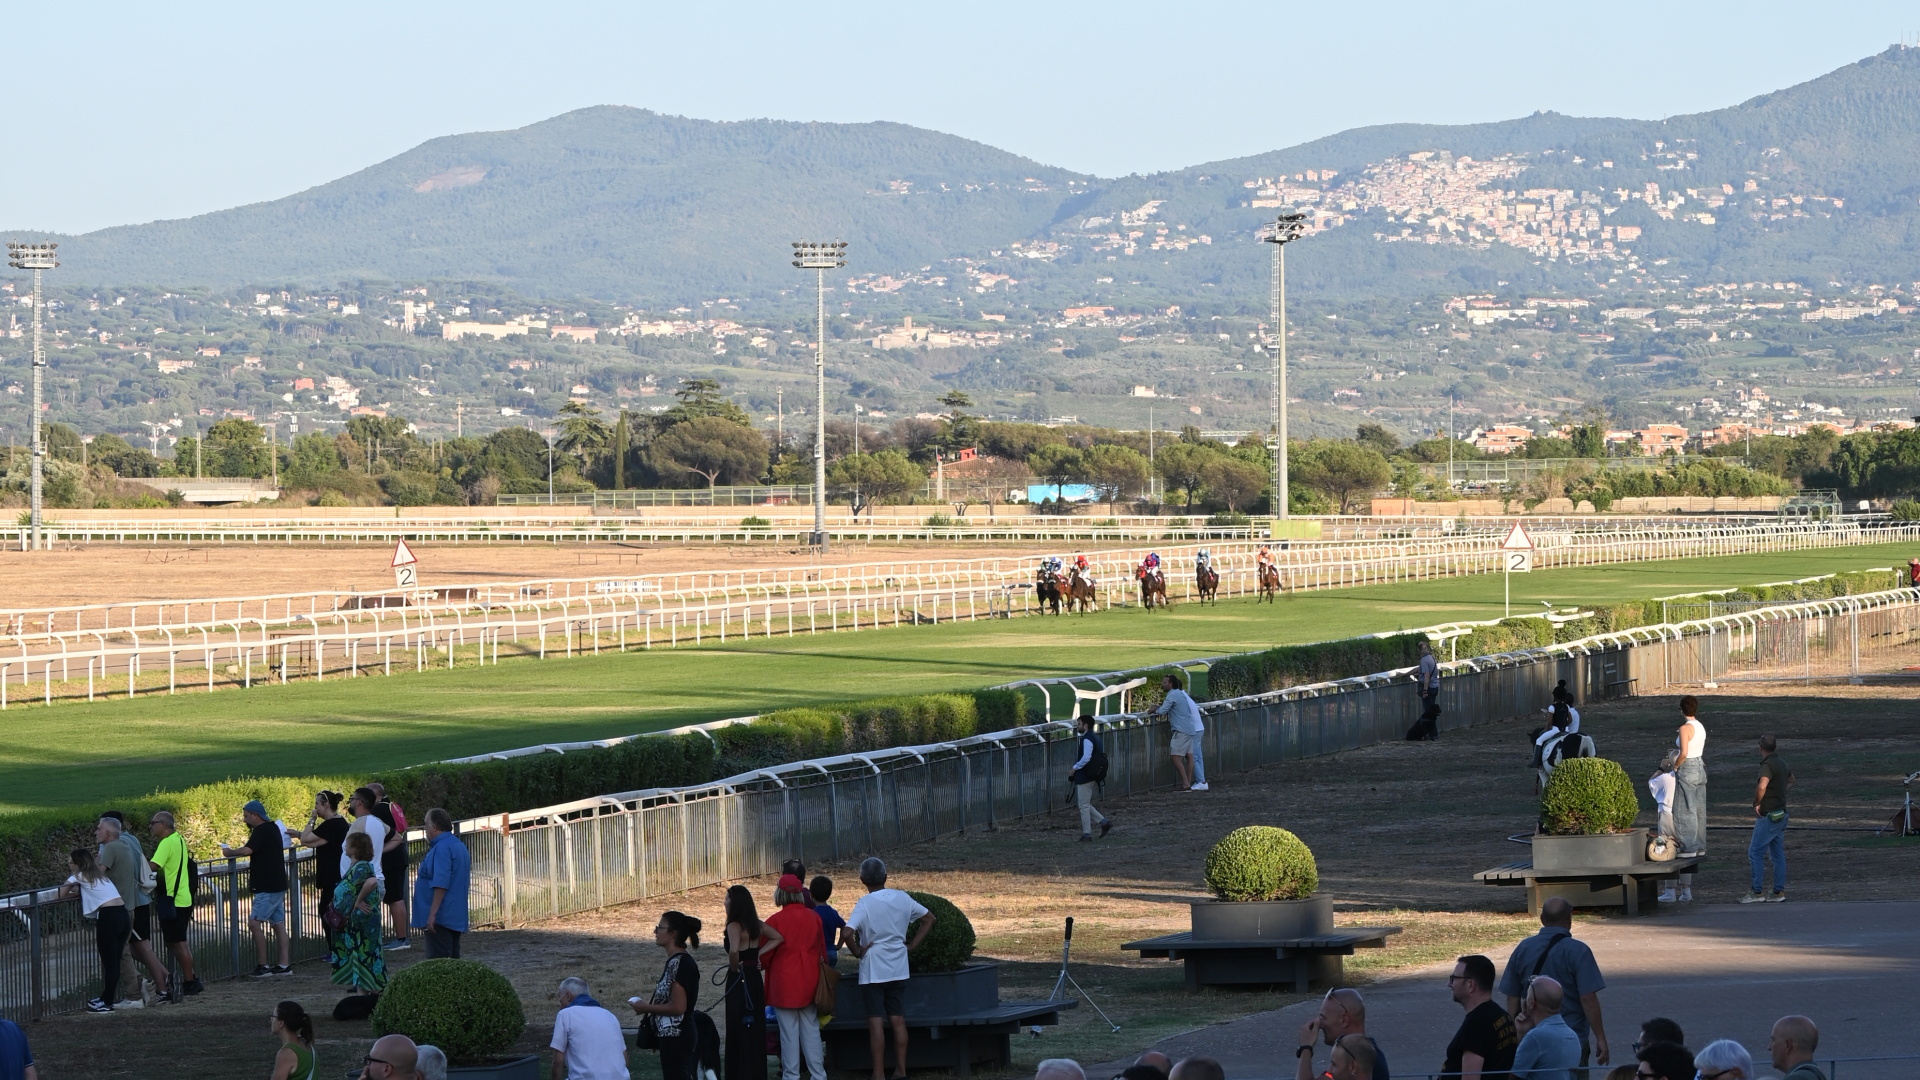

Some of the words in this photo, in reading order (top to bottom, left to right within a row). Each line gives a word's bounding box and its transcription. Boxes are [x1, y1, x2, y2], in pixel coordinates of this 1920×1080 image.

[1445, 521, 1452, 529] 4
[1511, 554, 1525, 570] 2
[400, 568, 413, 585] 2
